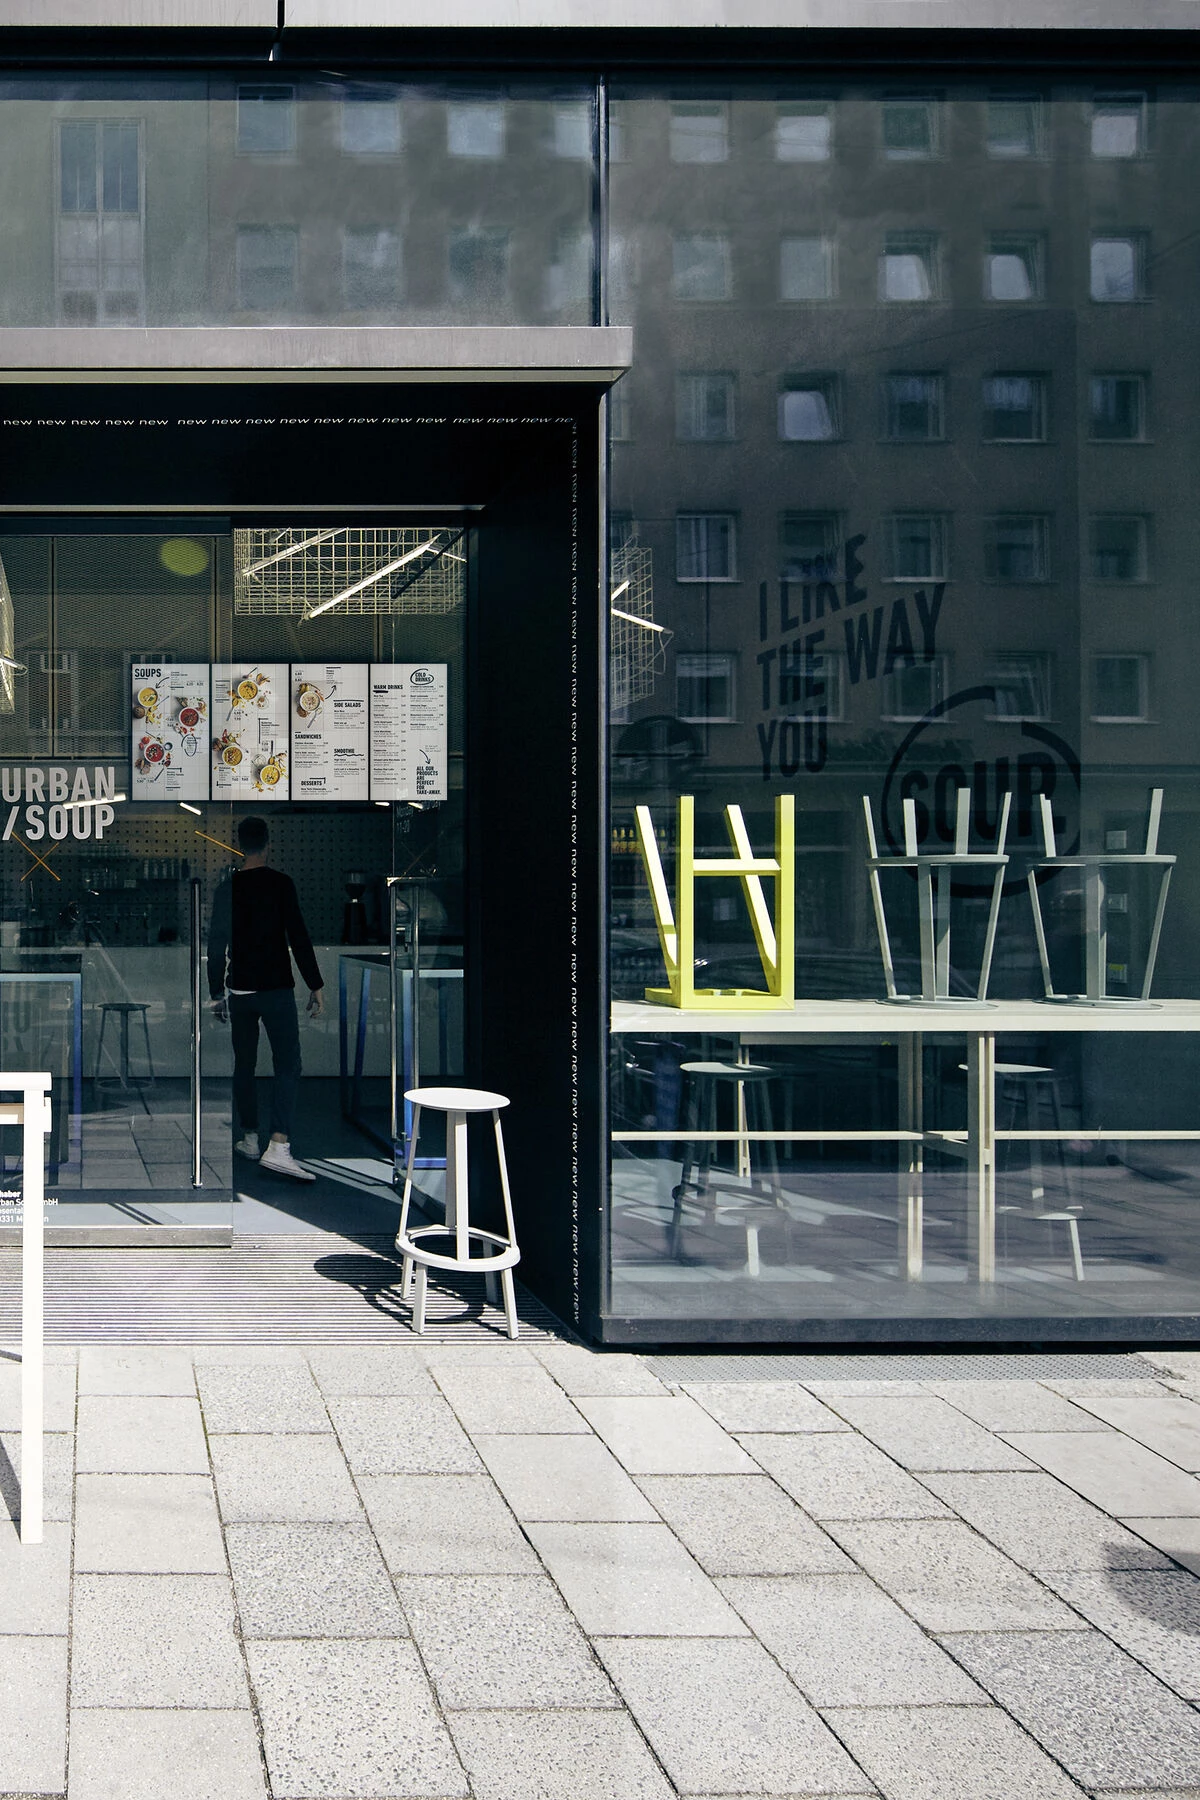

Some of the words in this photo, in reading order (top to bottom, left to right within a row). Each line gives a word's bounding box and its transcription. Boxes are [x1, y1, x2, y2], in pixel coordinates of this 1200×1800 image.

[759, 582, 767, 642] I
[780, 533, 868, 632] LIKE
[135, 668, 162, 678] SOUPS
[757, 631, 826, 711] THE
[844, 582, 946, 685] WAY
[757, 705, 829, 782] YOU
[1, 766, 116, 802] URBAN
[900, 751, 1068, 848] SOUP.
[1, 804, 116, 841] /SOUP
[43, 1198, 59, 1206] mbH
